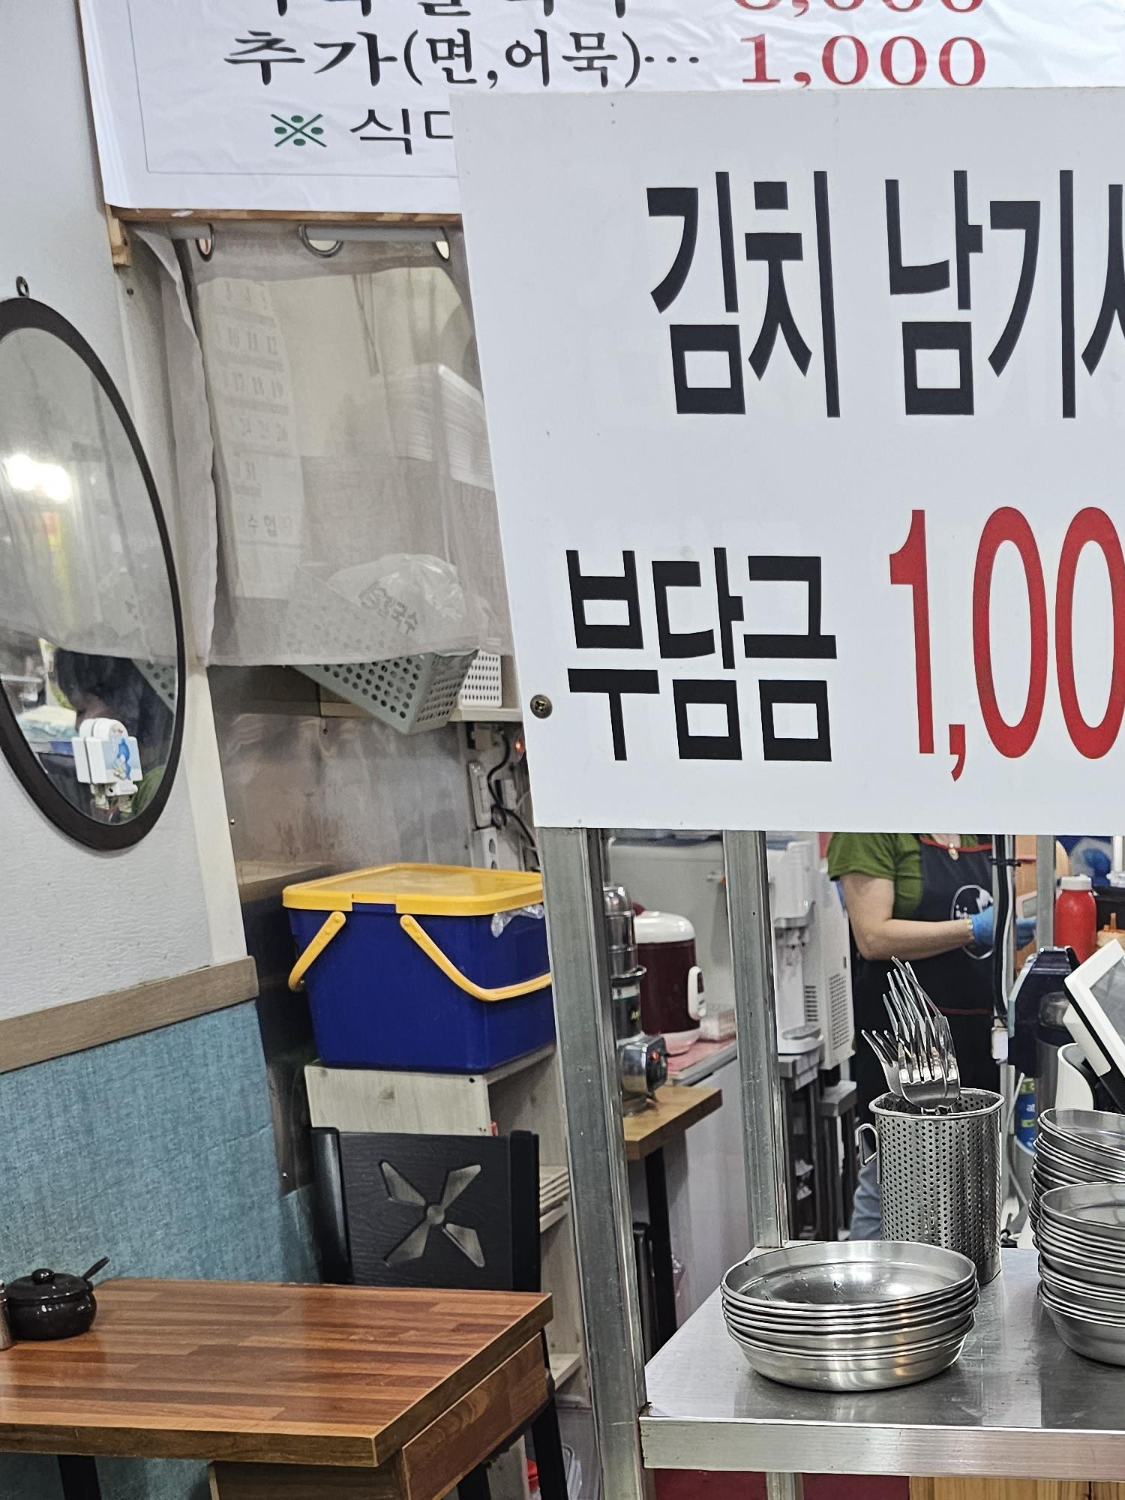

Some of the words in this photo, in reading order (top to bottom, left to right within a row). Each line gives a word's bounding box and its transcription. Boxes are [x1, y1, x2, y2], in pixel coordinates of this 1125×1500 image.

[740, 33, 986, 88] 1,000
[646, 170, 841, 418] 김치
[565, 547, 838, 762] 부담금
